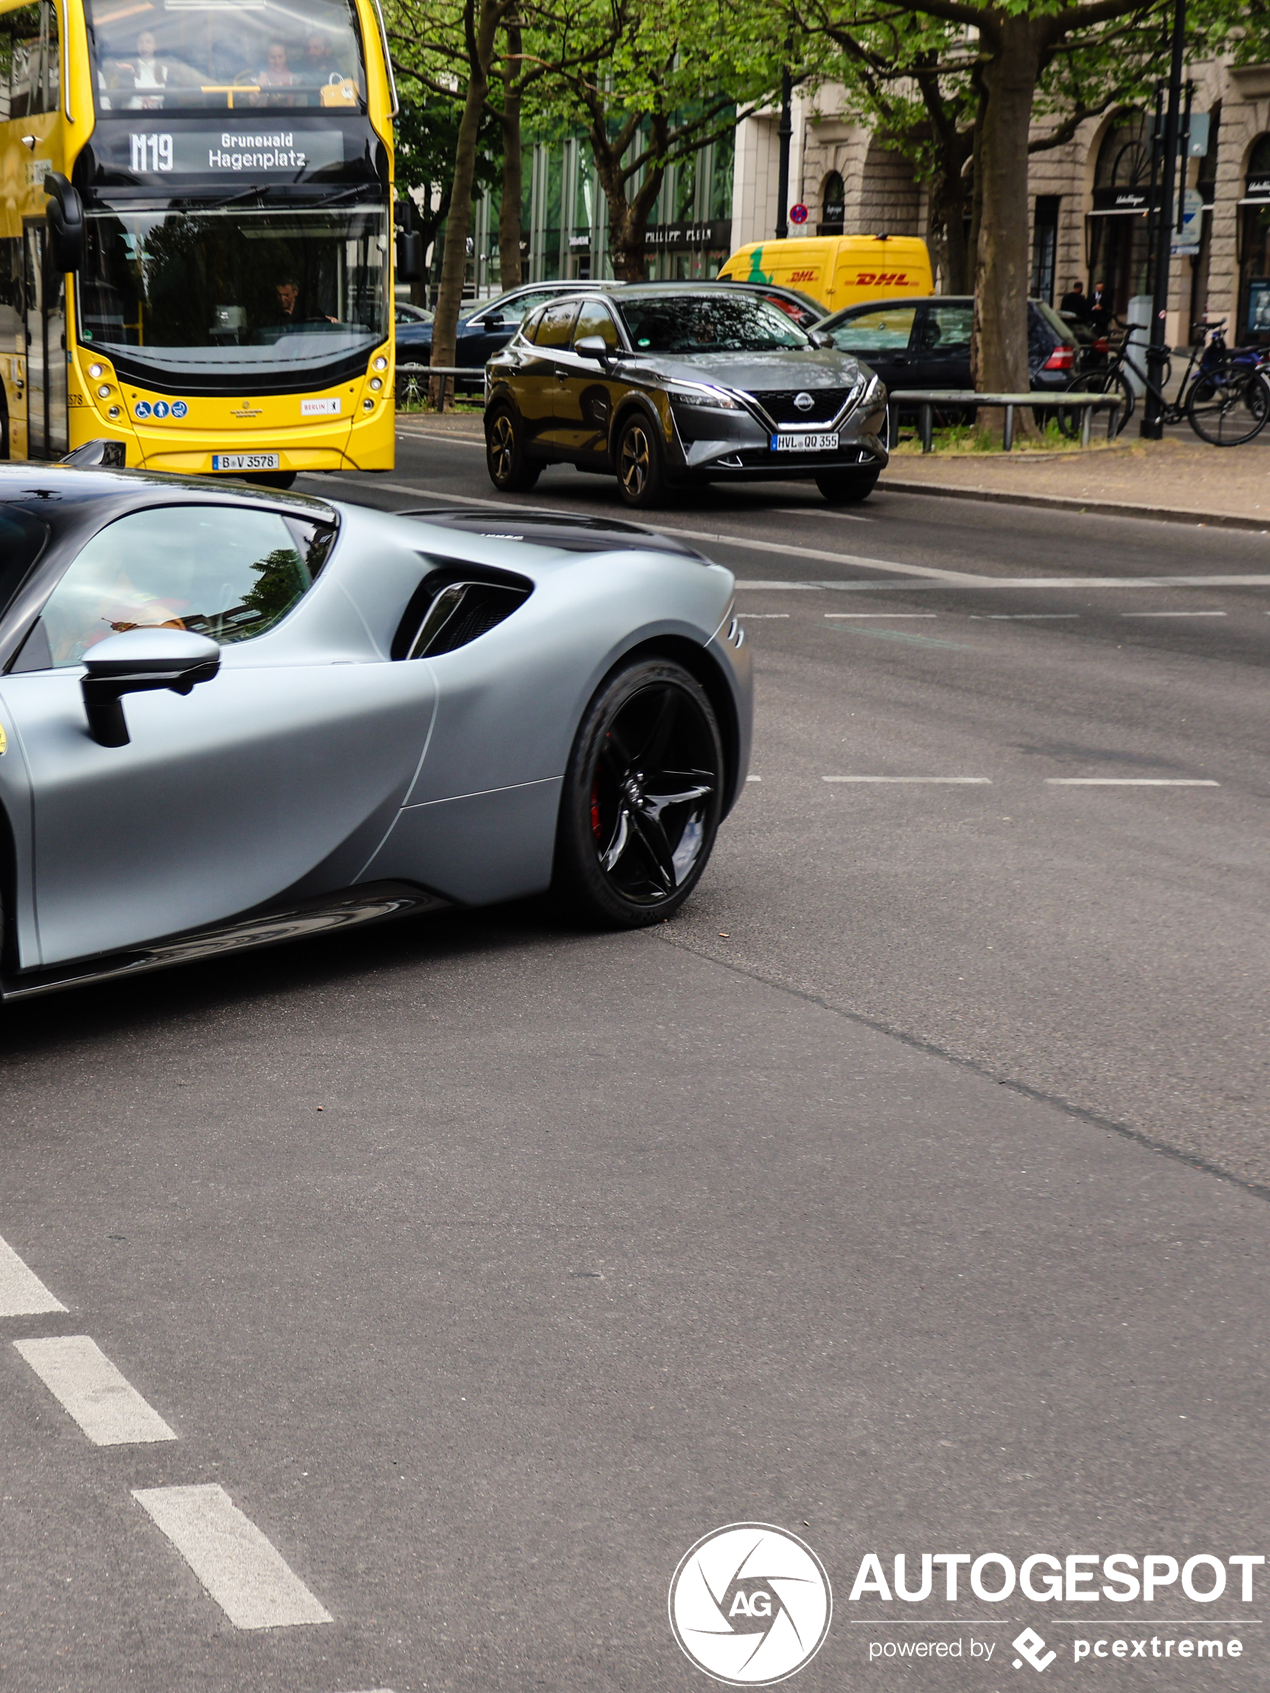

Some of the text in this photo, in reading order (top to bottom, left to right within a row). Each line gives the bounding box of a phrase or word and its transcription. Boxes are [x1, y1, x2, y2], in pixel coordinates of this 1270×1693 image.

[221, 132, 294, 148] Grunewald
[131, 133, 174, 172] M19
[208, 149, 307, 171] Hagenplatz
[686, 228, 712, 241] PLEIN
[789, 270, 815, 283] DHL
[855, 273, 910, 286] DHL
[304, 403, 327, 411] BERLIN
[778, 435, 837, 448] HVL QQ 355
[222, 455, 274, 468] B V 3578
